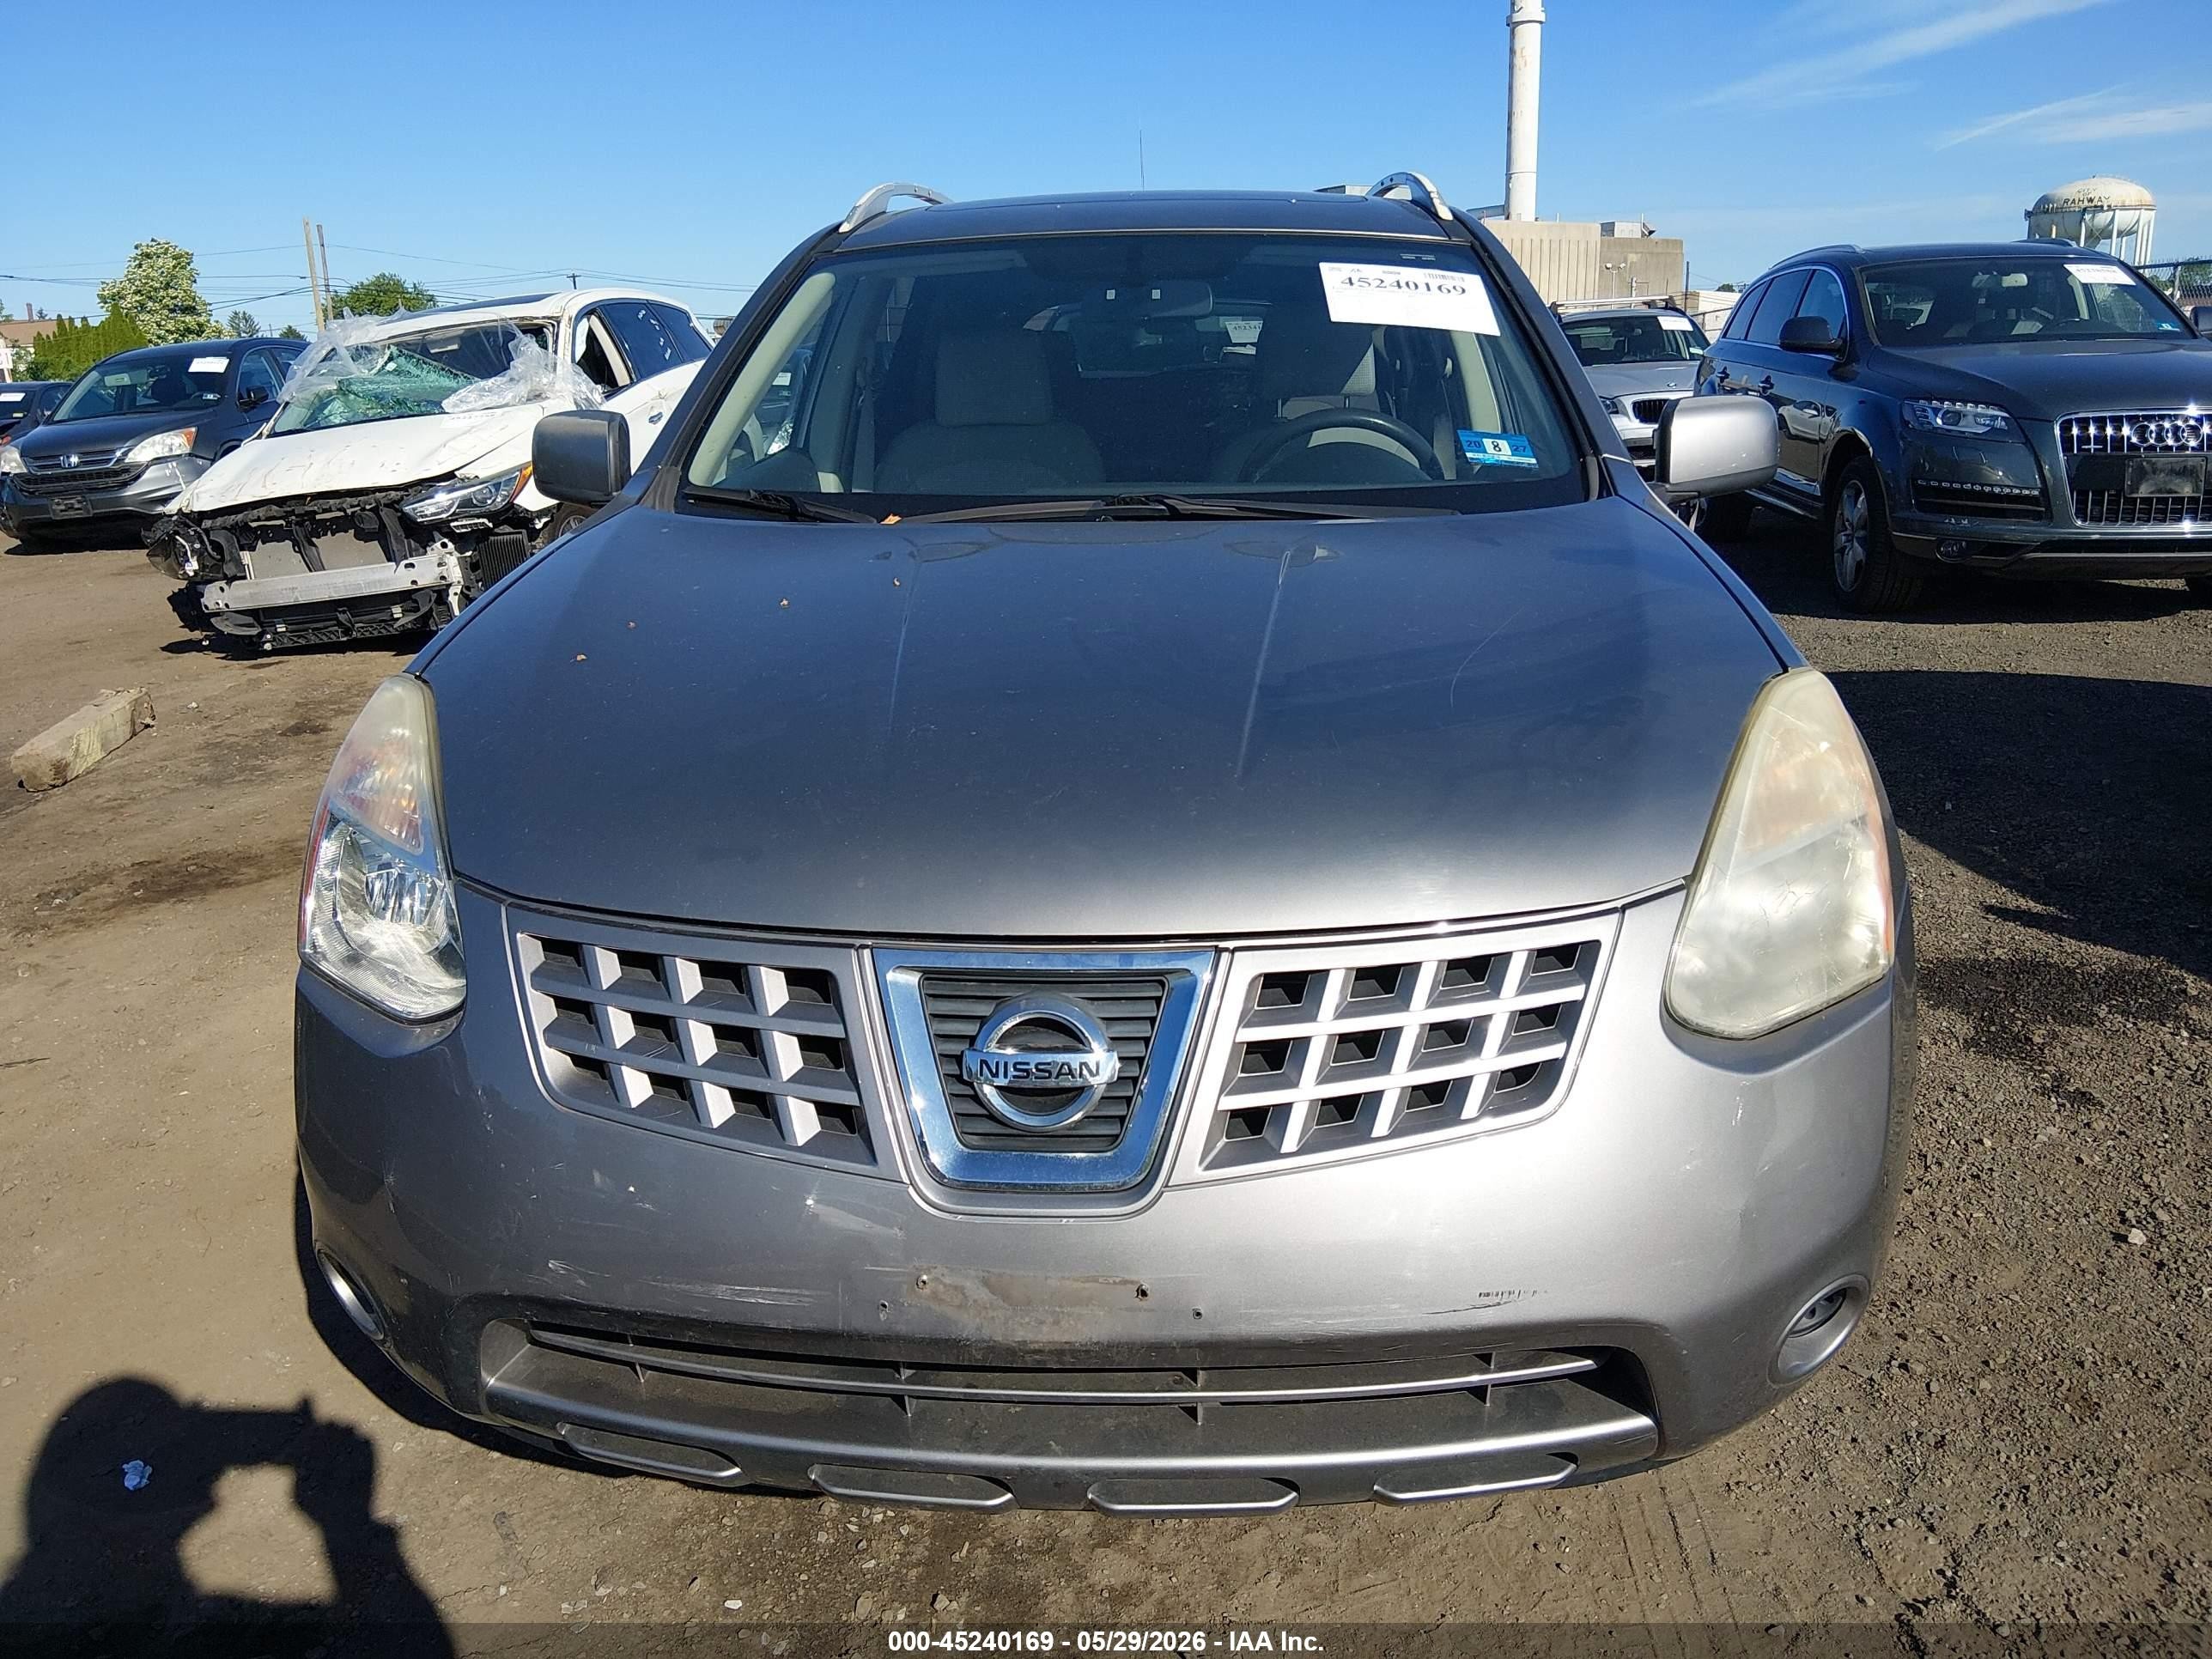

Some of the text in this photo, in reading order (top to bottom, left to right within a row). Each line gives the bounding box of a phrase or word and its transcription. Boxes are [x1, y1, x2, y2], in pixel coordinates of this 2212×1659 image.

[2063, 195, 2111, 207] RAHWAY
[1340, 276, 1467, 296] 45240169
[1466, 440, 1527, 453] 20 8 27
[978, 1058, 1101, 1080] NISSAN
